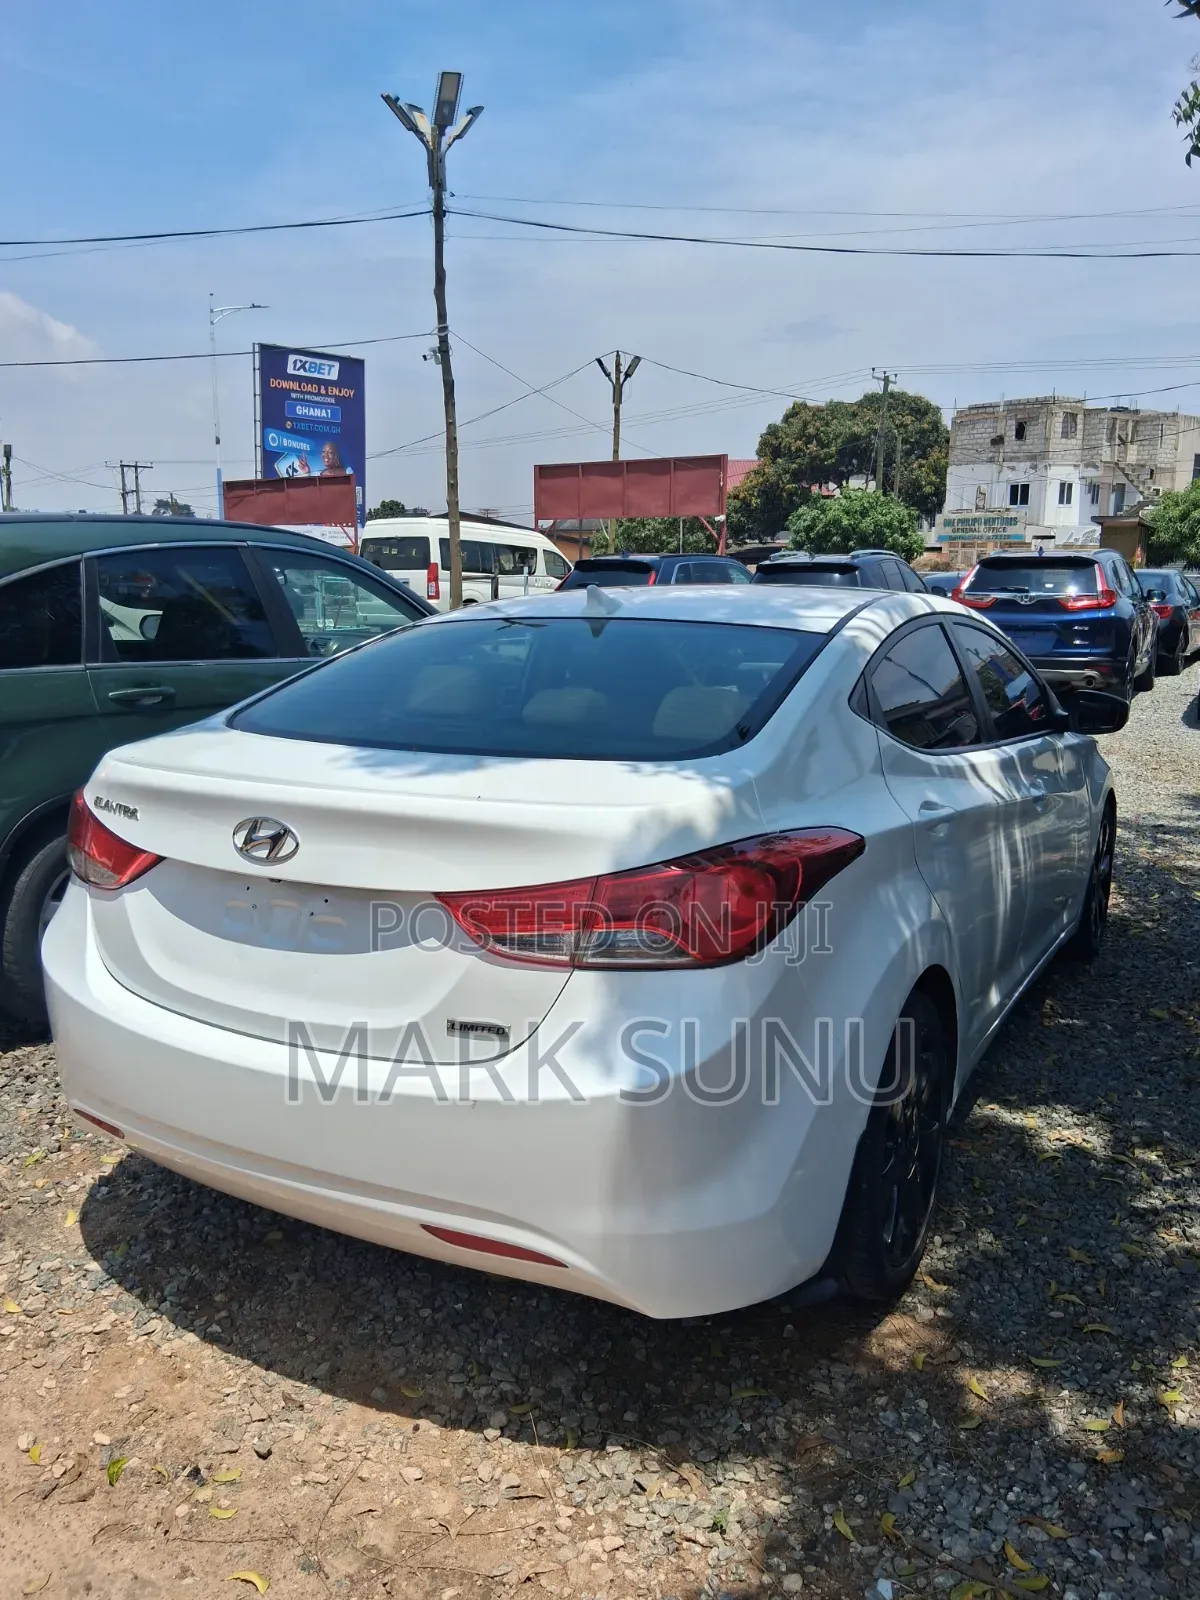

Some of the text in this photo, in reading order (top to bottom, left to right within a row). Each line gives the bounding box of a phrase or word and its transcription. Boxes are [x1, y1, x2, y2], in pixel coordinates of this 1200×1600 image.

[292, 358, 336, 377] 1XBET
[269, 377, 355, 398] DOWNLOAD & ENJOY
[290, 392, 336, 404] WITH PROMOCODE
[296, 405, 332, 419] GHANA1
[282, 438, 311, 452] BONUSES
[983, 516, 1018, 527] VENTURES
[983, 526, 1008, 534] OFFICE
[94, 795, 140, 821] ELANTRA
[450, 1022, 506, 1036] LIMITED
